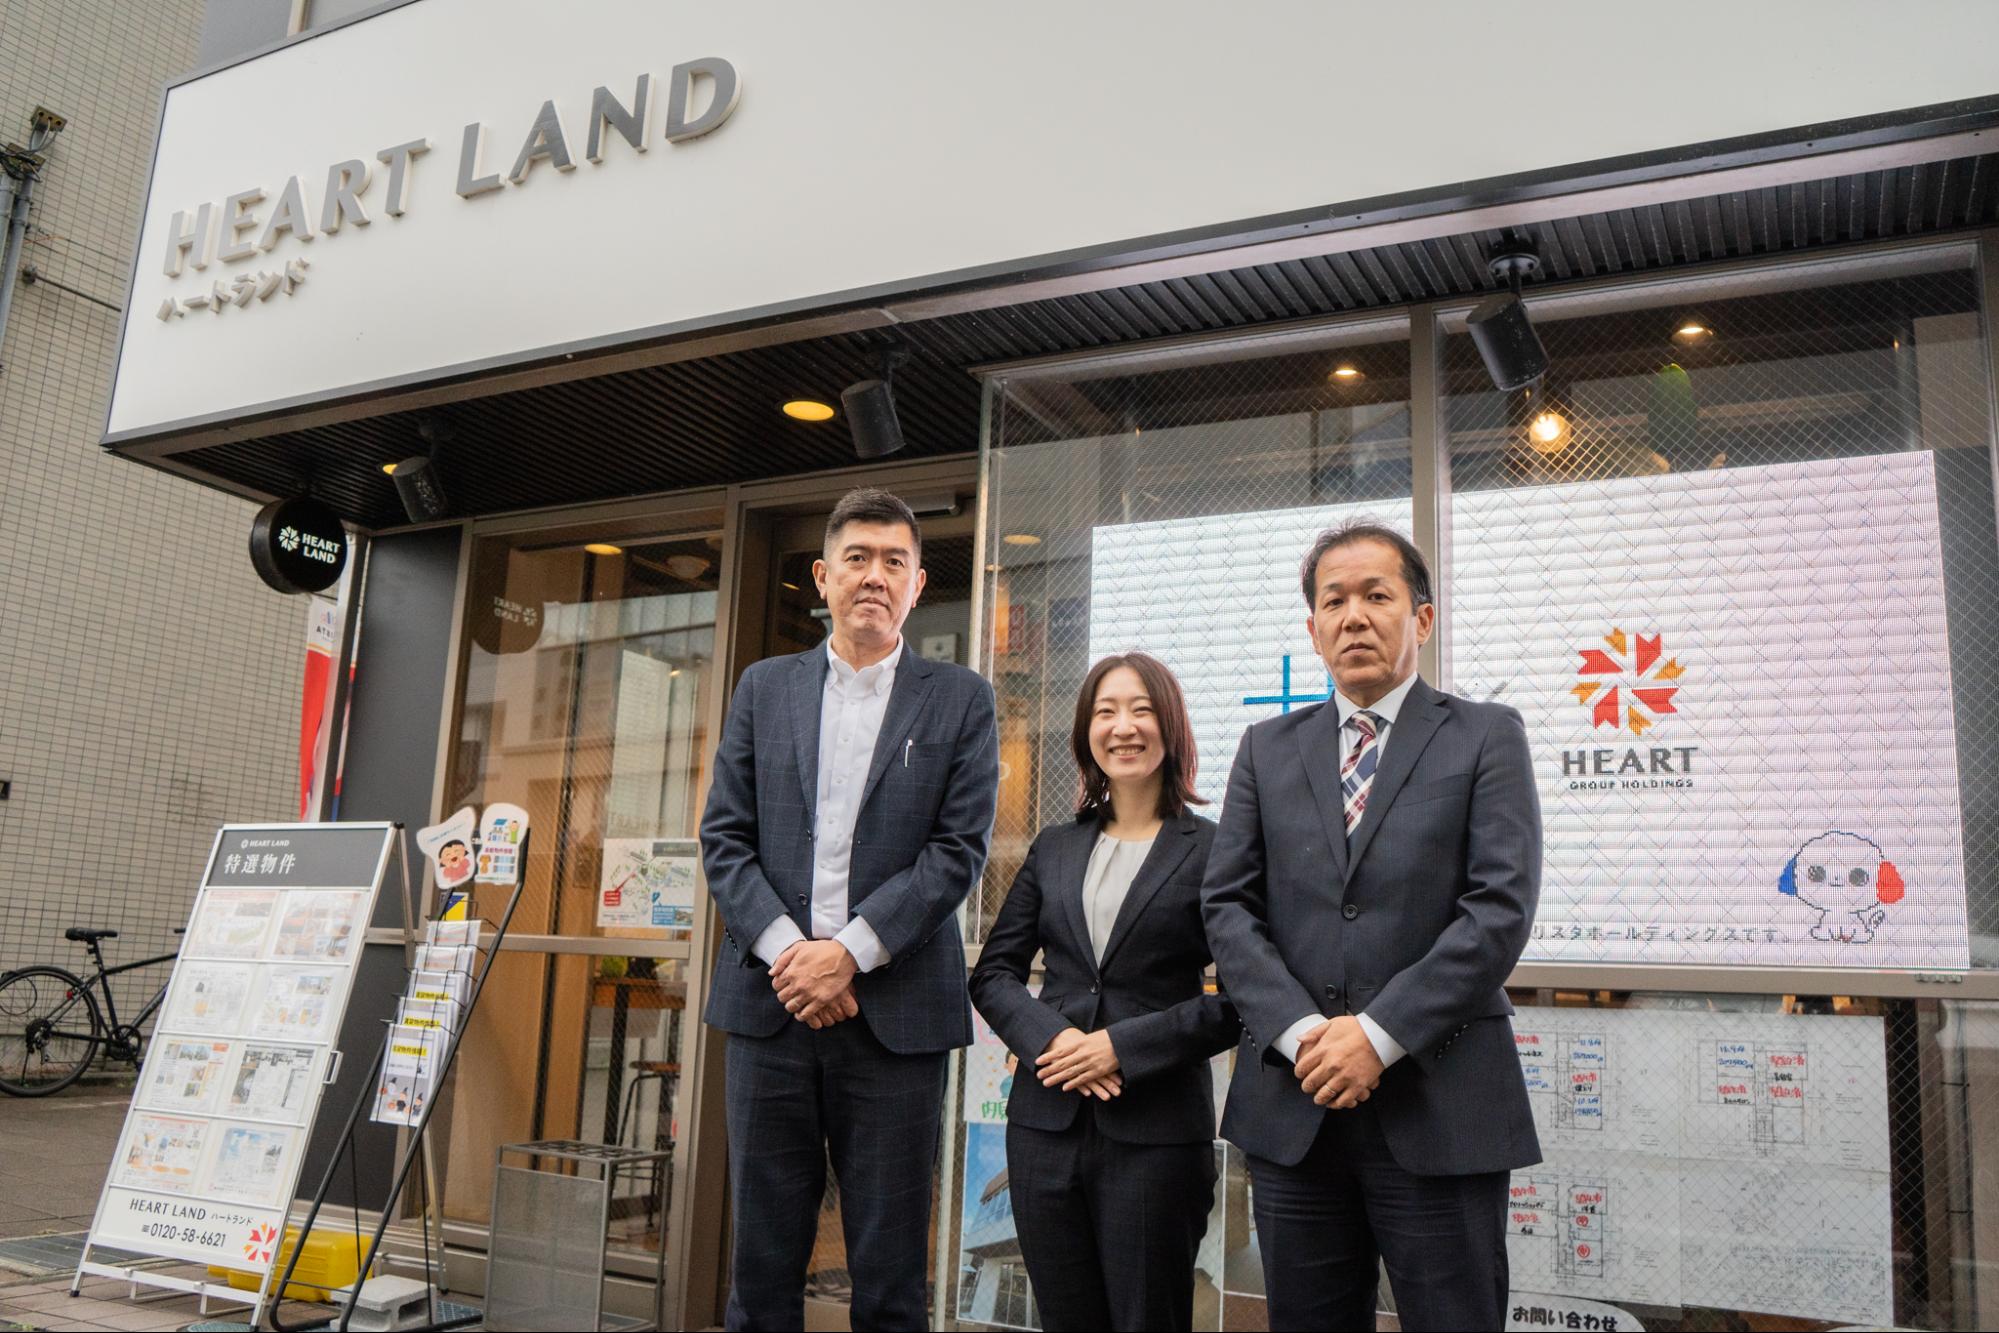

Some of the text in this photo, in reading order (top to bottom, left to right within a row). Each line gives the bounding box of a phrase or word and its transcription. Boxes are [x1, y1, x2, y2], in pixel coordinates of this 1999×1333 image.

[161, 55, 742, 279] HEART LAND
[156, 257, 311, 322] ハートランド
[302, 533, 340, 554] HEART
[303, 546, 336, 564] LAND
[1562, 746, 1699, 776] HEART
[1569, 779, 1694, 790] GROUP HOLDINGS
[249, 839, 290, 847] HEART LAND
[224, 853, 296, 875] 特選物件
[129, 1198, 254, 1226] HEART LAND ハートランド
[150, 1222, 226, 1248] 0120-58-6621
[1512, 1306, 1618, 1332] お問い合わせ
